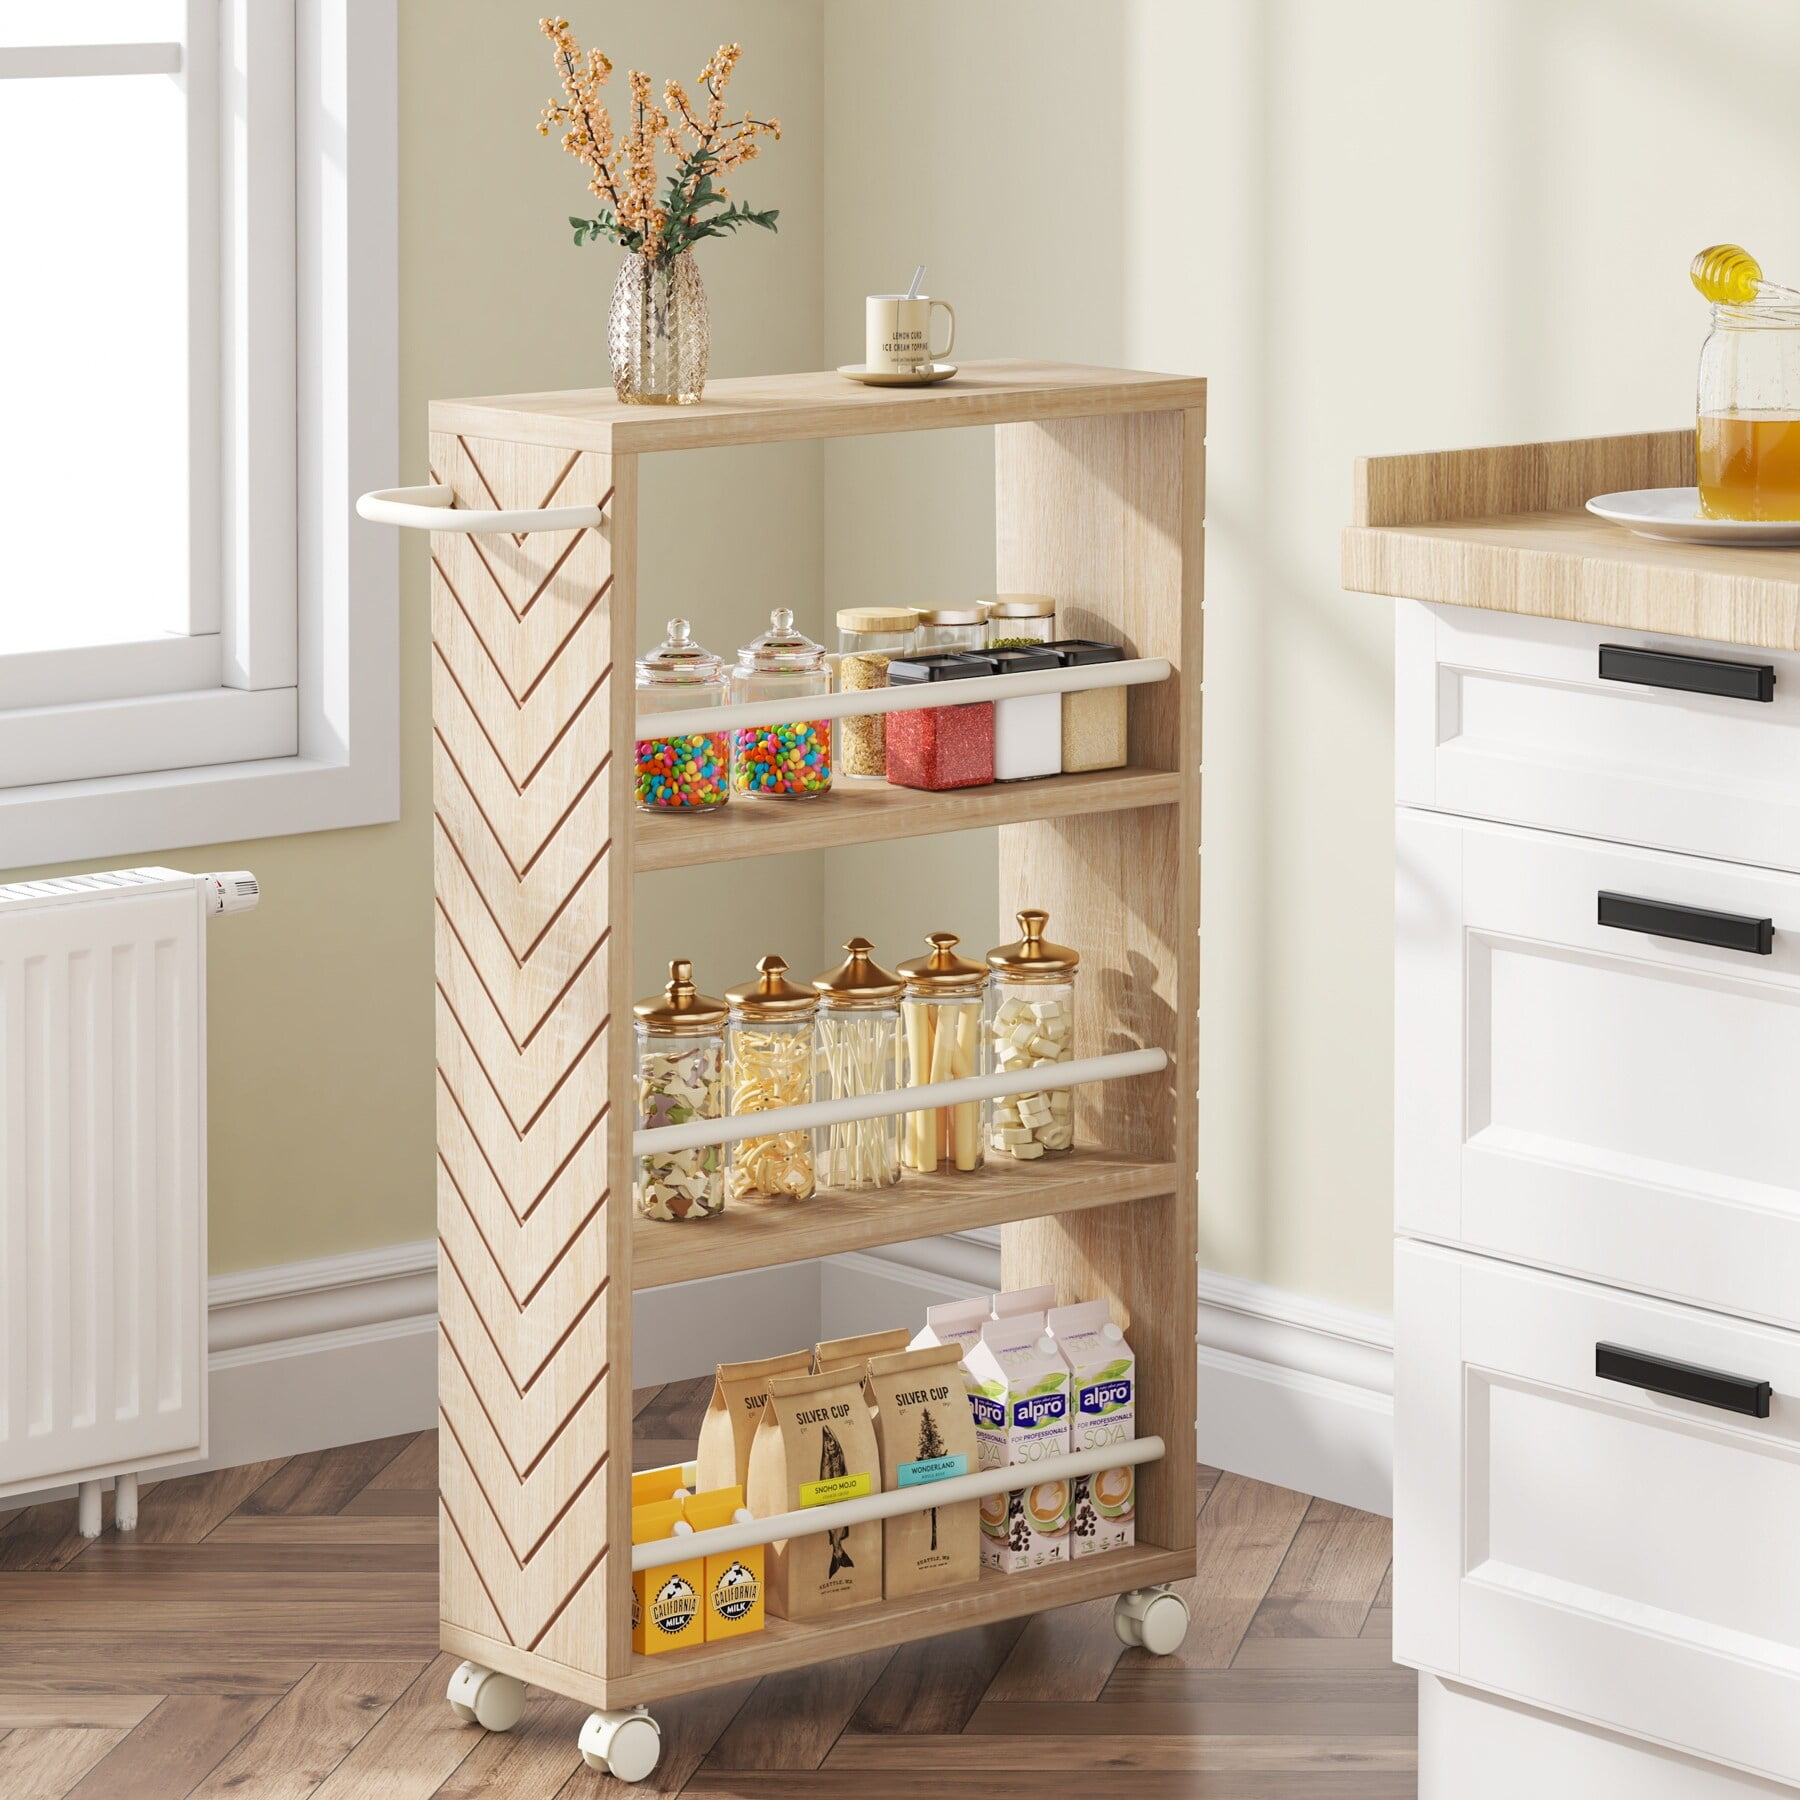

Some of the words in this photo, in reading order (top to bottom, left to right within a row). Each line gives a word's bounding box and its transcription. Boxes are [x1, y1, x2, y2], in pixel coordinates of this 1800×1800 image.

[744, 1393, 768, 1409] SILV
[895, 1390, 929, 1407] SILVER
[930, 1386, 949, 1401] CUP
[1084, 1386, 1127, 1408] alpro
[795, 1408, 830, 1425] SILVER
[830, 1404, 850, 1419] CUP
[1018, 1400, 1062, 1422] alpro
[1077, 1421, 1089, 1429] FOR
[1089, 1412, 1133, 1426] PROFESSIONALS
[976, 1430, 1007, 1444] OFESSIONALS
[1011, 1436, 1023, 1444] FOR
[1023, 1427, 1068, 1441] PROFESSIONALS
[1083, 1424, 1127, 1450] SOYA
[976, 1440, 1002, 1464] OYA
[1018, 1438, 1061, 1465] SOYA
[911, 1461, 955, 1474] WONDERLAND
[814, 1484, 838, 1495] SNOHO
[838, 1480, 857, 1490] MOJO
[714, 1585, 757, 1606] CALIFORNIA
[653, 1598, 697, 1619] CALIFORNIA
[726, 1602, 746, 1614] MILK
[665, 1615, 685, 1627] MILK
